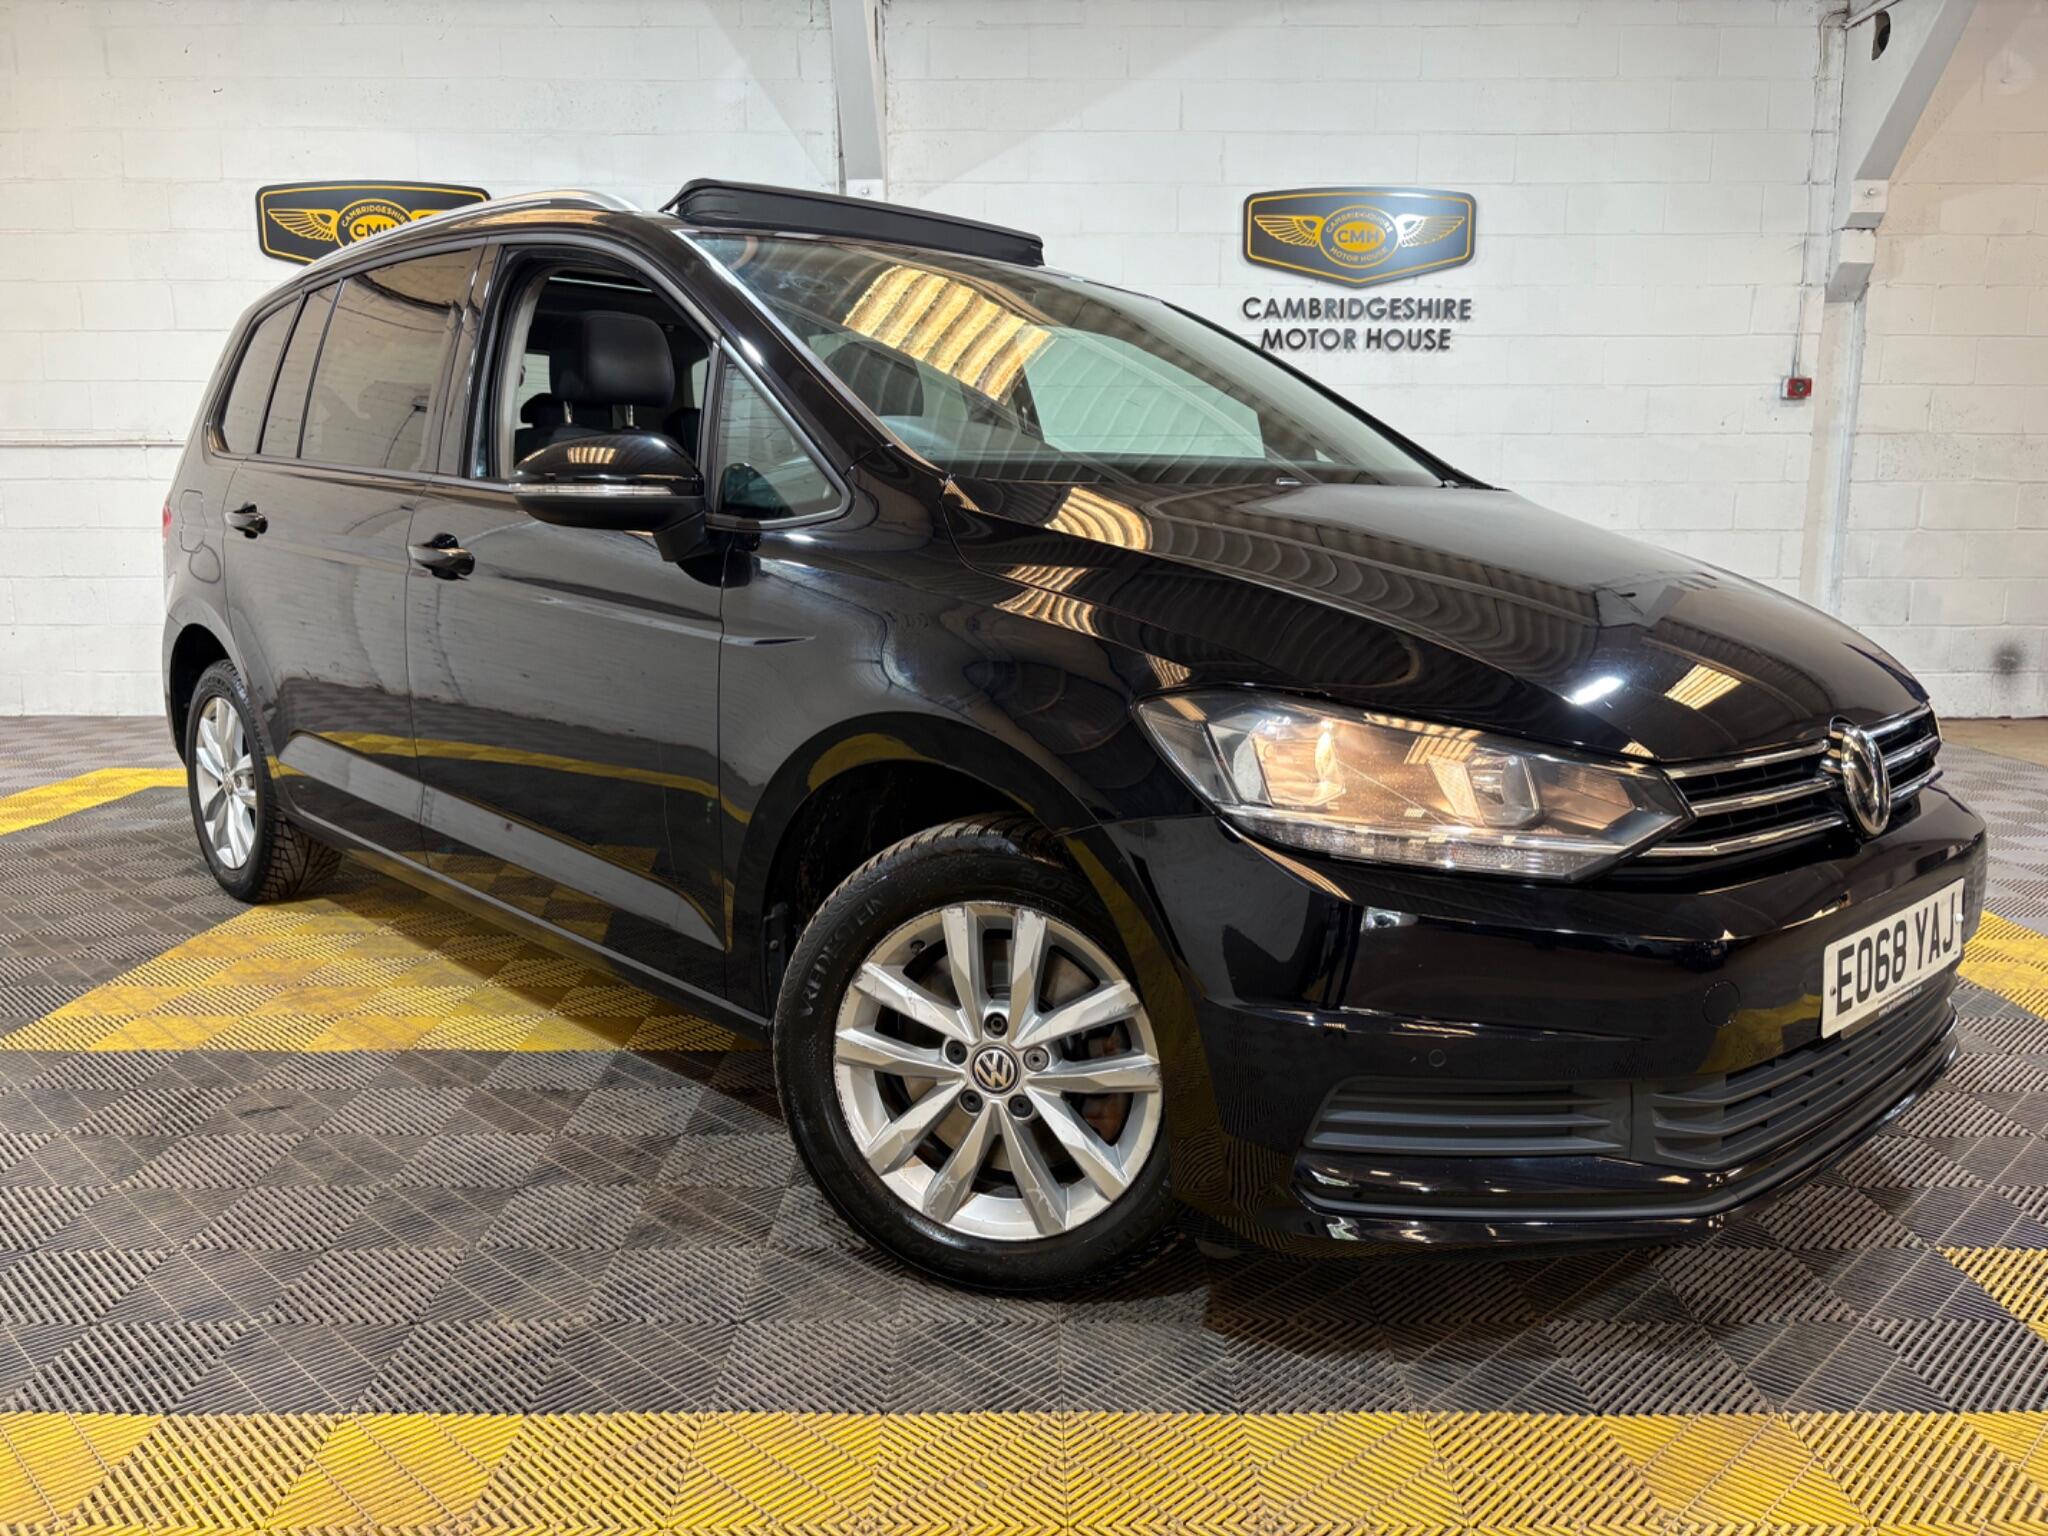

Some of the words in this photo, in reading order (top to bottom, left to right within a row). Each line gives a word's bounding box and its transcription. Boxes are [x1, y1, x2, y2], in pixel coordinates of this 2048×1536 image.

[342, 204, 408, 228] CAMBRIDGESHIR
[1327, 210, 1393, 232] CAMBRIDGESHIRE
[1337, 229, 1381, 245] CMH
[1330, 246, 1360, 262] MOTOR
[1361, 247, 1389, 262] HOUSE
[1242, 297, 1473, 321] CAMBRIDGESHIRE
[1261, 327, 1358, 351] MOTOR
[1366, 327, 1452, 351] HOUSE
[1915, 891, 1956, 970] YAJ
